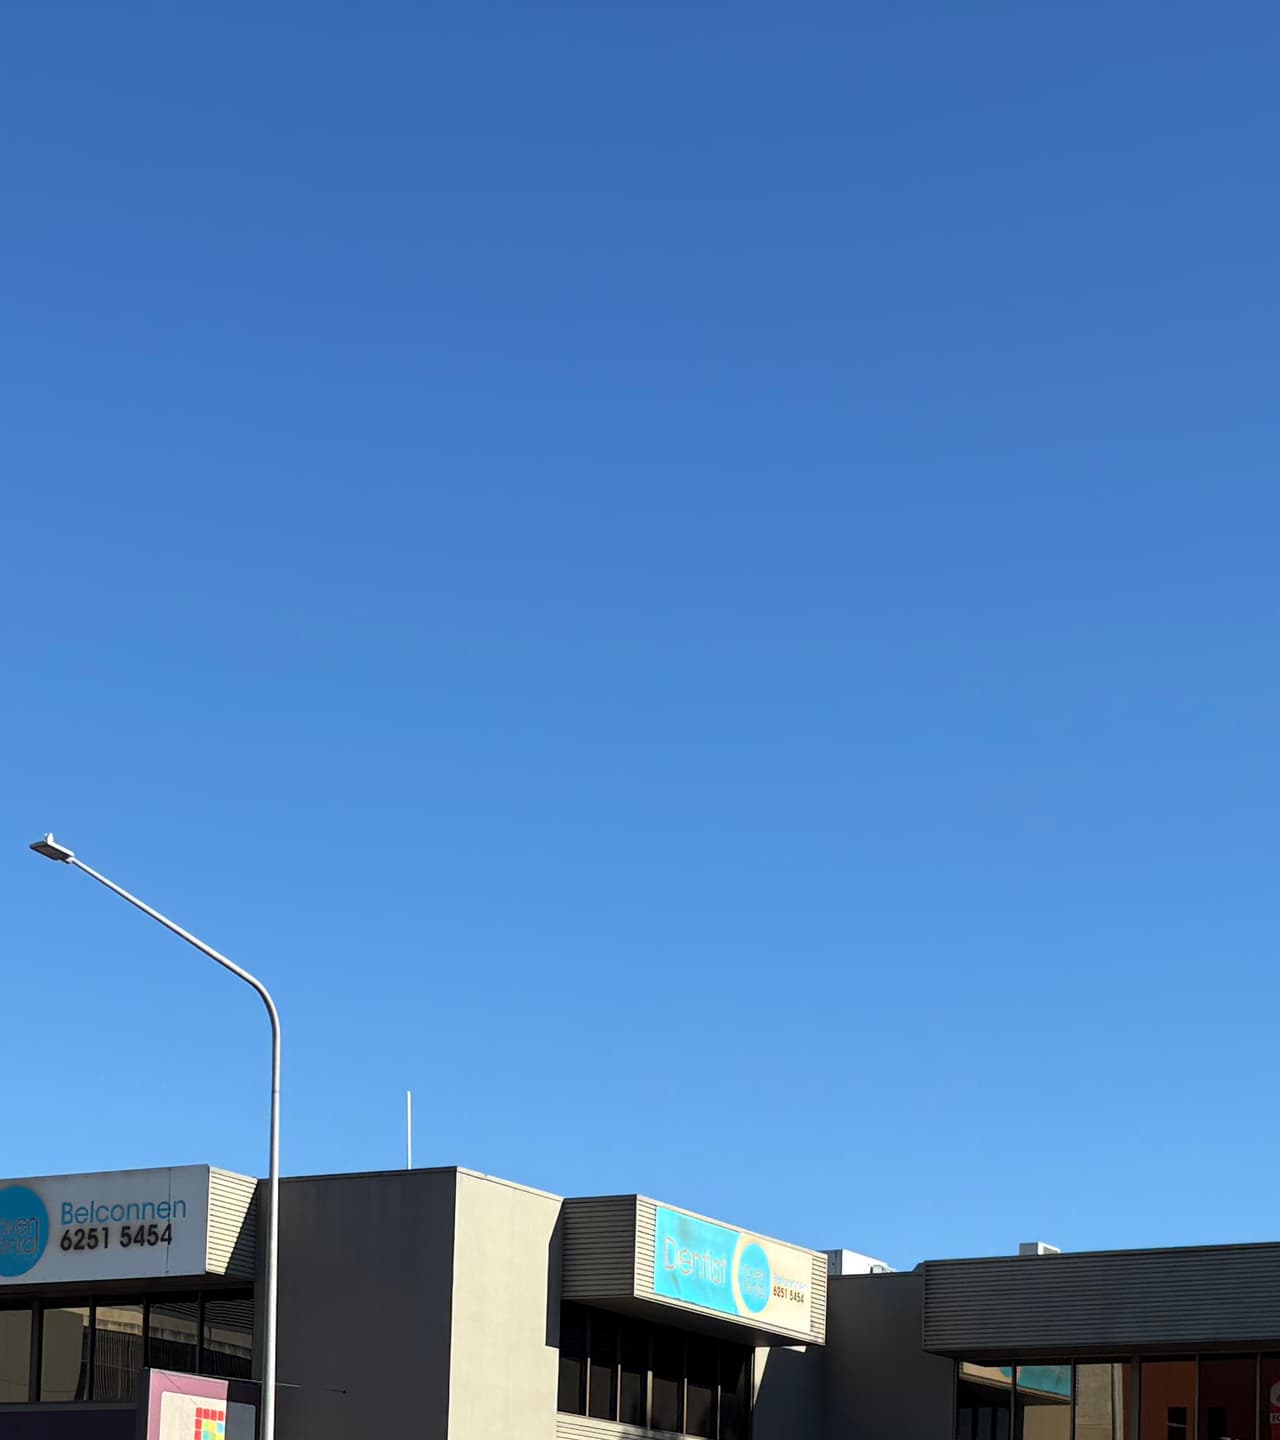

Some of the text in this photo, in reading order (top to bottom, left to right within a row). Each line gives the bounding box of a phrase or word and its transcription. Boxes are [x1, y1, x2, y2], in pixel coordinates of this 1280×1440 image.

[60, 1199, 187, 1225] Belconnen
[60, 1224, 173, 1251] 6251 5454
[663, 1236, 727, 1285] Dentist
[773, 1285, 805, 1304] 6251 5454
